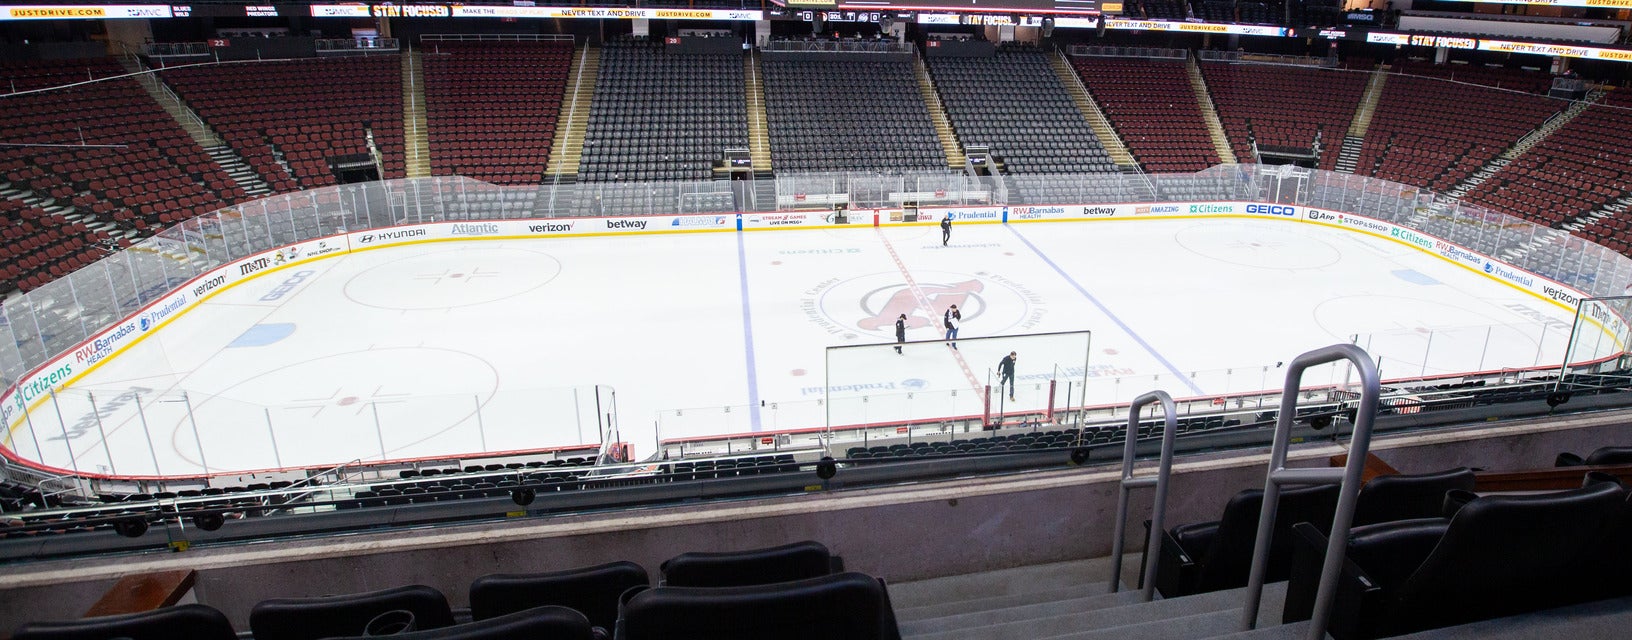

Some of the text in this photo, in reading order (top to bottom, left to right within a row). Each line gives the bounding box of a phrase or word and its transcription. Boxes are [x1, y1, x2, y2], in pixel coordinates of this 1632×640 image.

[373, 5, 449, 17] STAY FOCUSED
[1412, 36, 1435, 46] STAY
[1500, 43, 1525, 51] NEVER
[1083, 207, 1116, 216] betway
[1199, 205, 1233, 213] Citizens
[1246, 204, 1295, 216] GEICO
[958, 211, 997, 220] Prudential
[452, 223, 499, 234] Atlantic
[529, 222, 571, 232] verizon
[607, 218, 647, 230] betway
[1344, 218, 1388, 232] STOP&SHOP
[379, 228, 426, 240] HYUNDAI
[1400, 230, 1433, 248] Citizens
[1495, 267, 1533, 287] Prudential
[193, 276, 224, 297] verizon
[1543, 286, 1578, 306] verizon
[150, 296, 187, 323] Prudential
[87, 346, 113, 366] HEALTH
[23, 363, 72, 401] Citizens
